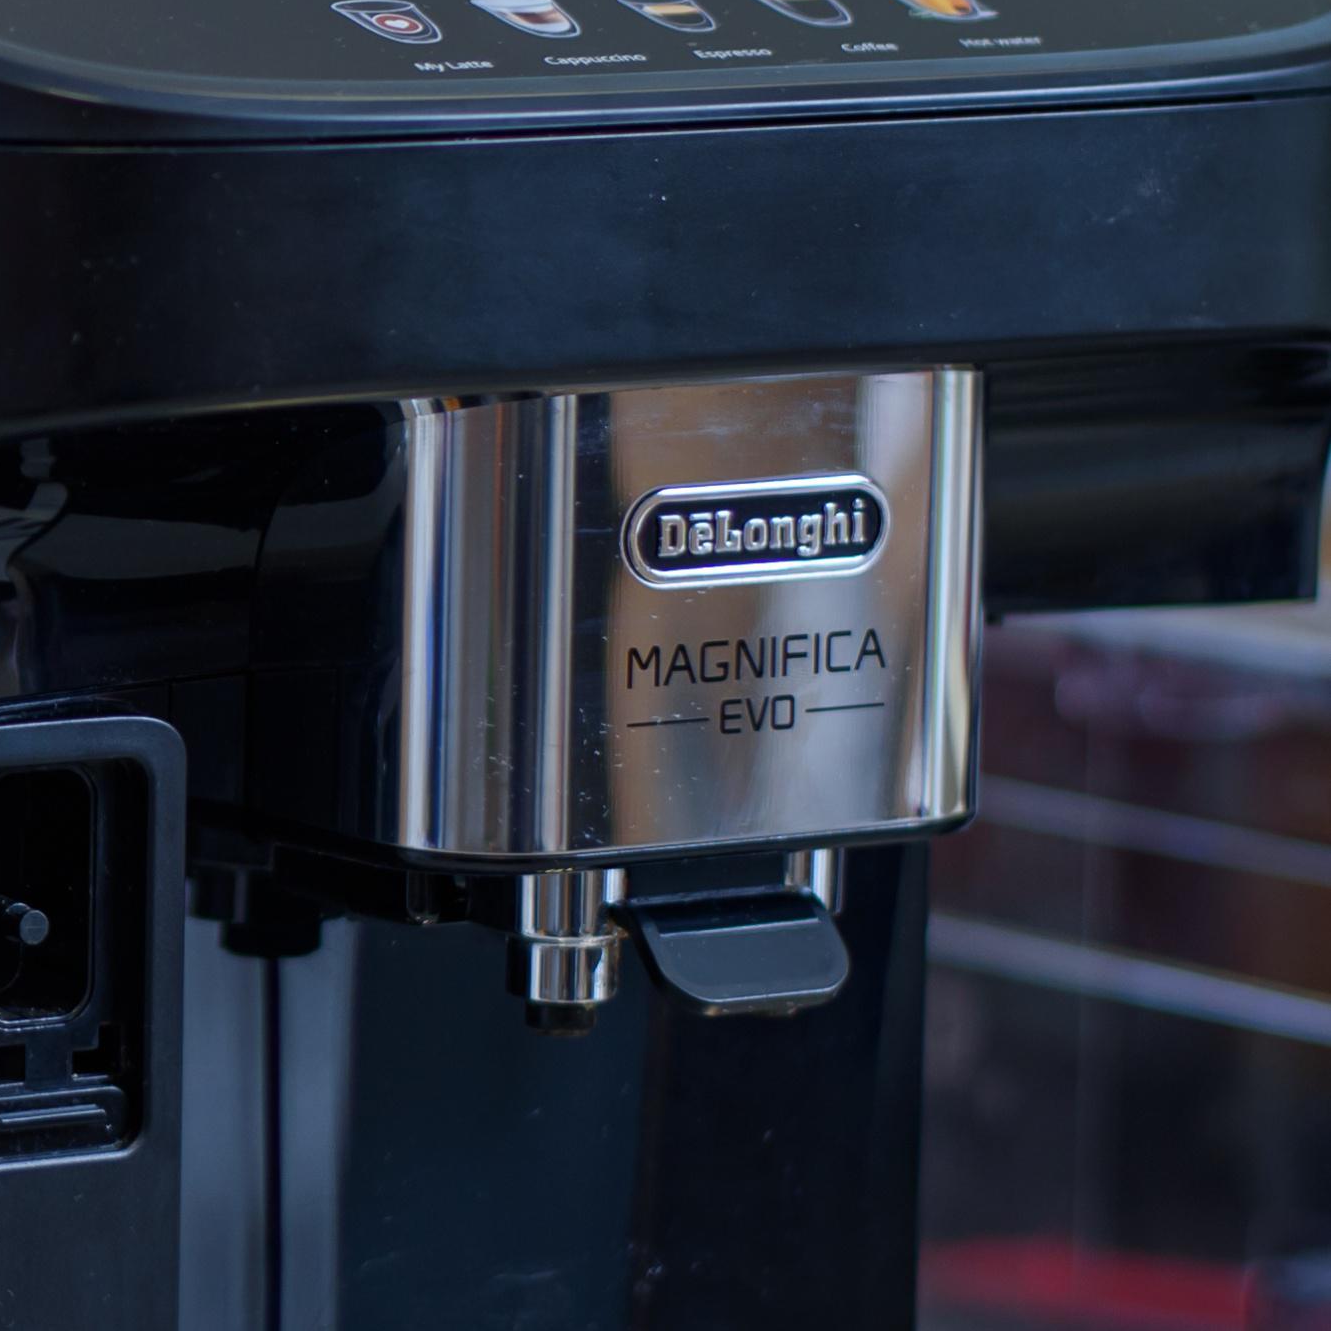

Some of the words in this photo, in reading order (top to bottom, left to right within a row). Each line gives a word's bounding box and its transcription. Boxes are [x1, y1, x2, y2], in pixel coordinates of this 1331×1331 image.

[840, 41, 899, 54] Coffee
[958, 37, 993, 49] Hot
[998, 35, 1042, 47] water
[544, 53, 648, 67] Cappuccino
[693, 46, 773, 61] Espresso
[413, 61, 445, 73] My
[445, 59, 494, 71] Latte
[626, 627, 886, 690] MAGNIFICA
[719, 694, 796, 735] EVO
